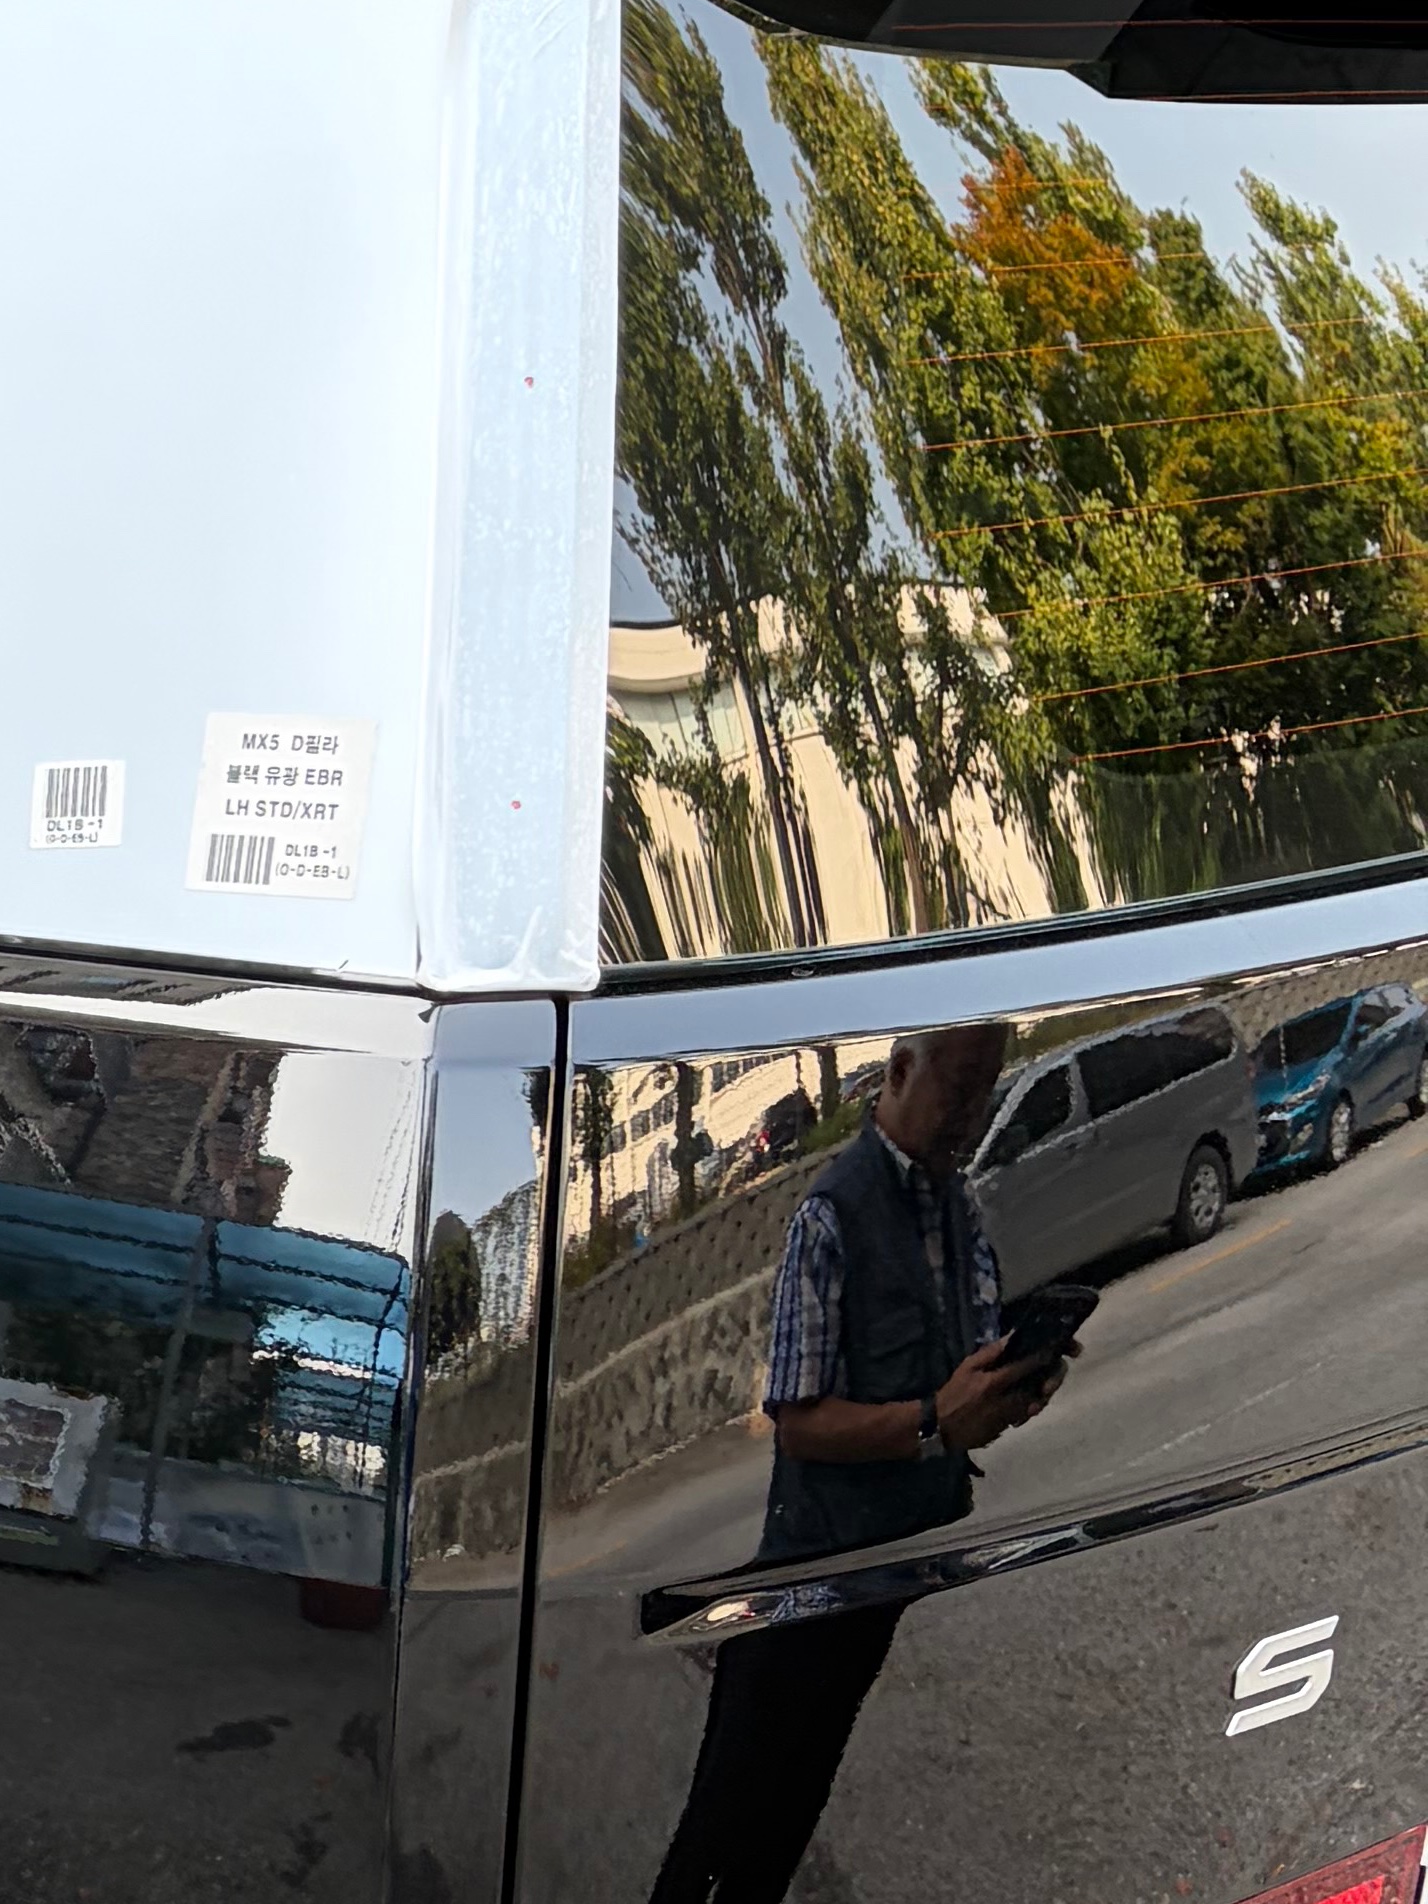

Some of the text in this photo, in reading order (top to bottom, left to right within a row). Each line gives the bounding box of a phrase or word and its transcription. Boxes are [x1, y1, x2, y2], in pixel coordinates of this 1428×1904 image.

[241, 733, 339, 755] MX5 D필라
[226, 764, 343, 787] 블랙 유광 EBR
[225, 798, 339, 821] LH STD/XRT
[1225, 1615, 1339, 1737] S
